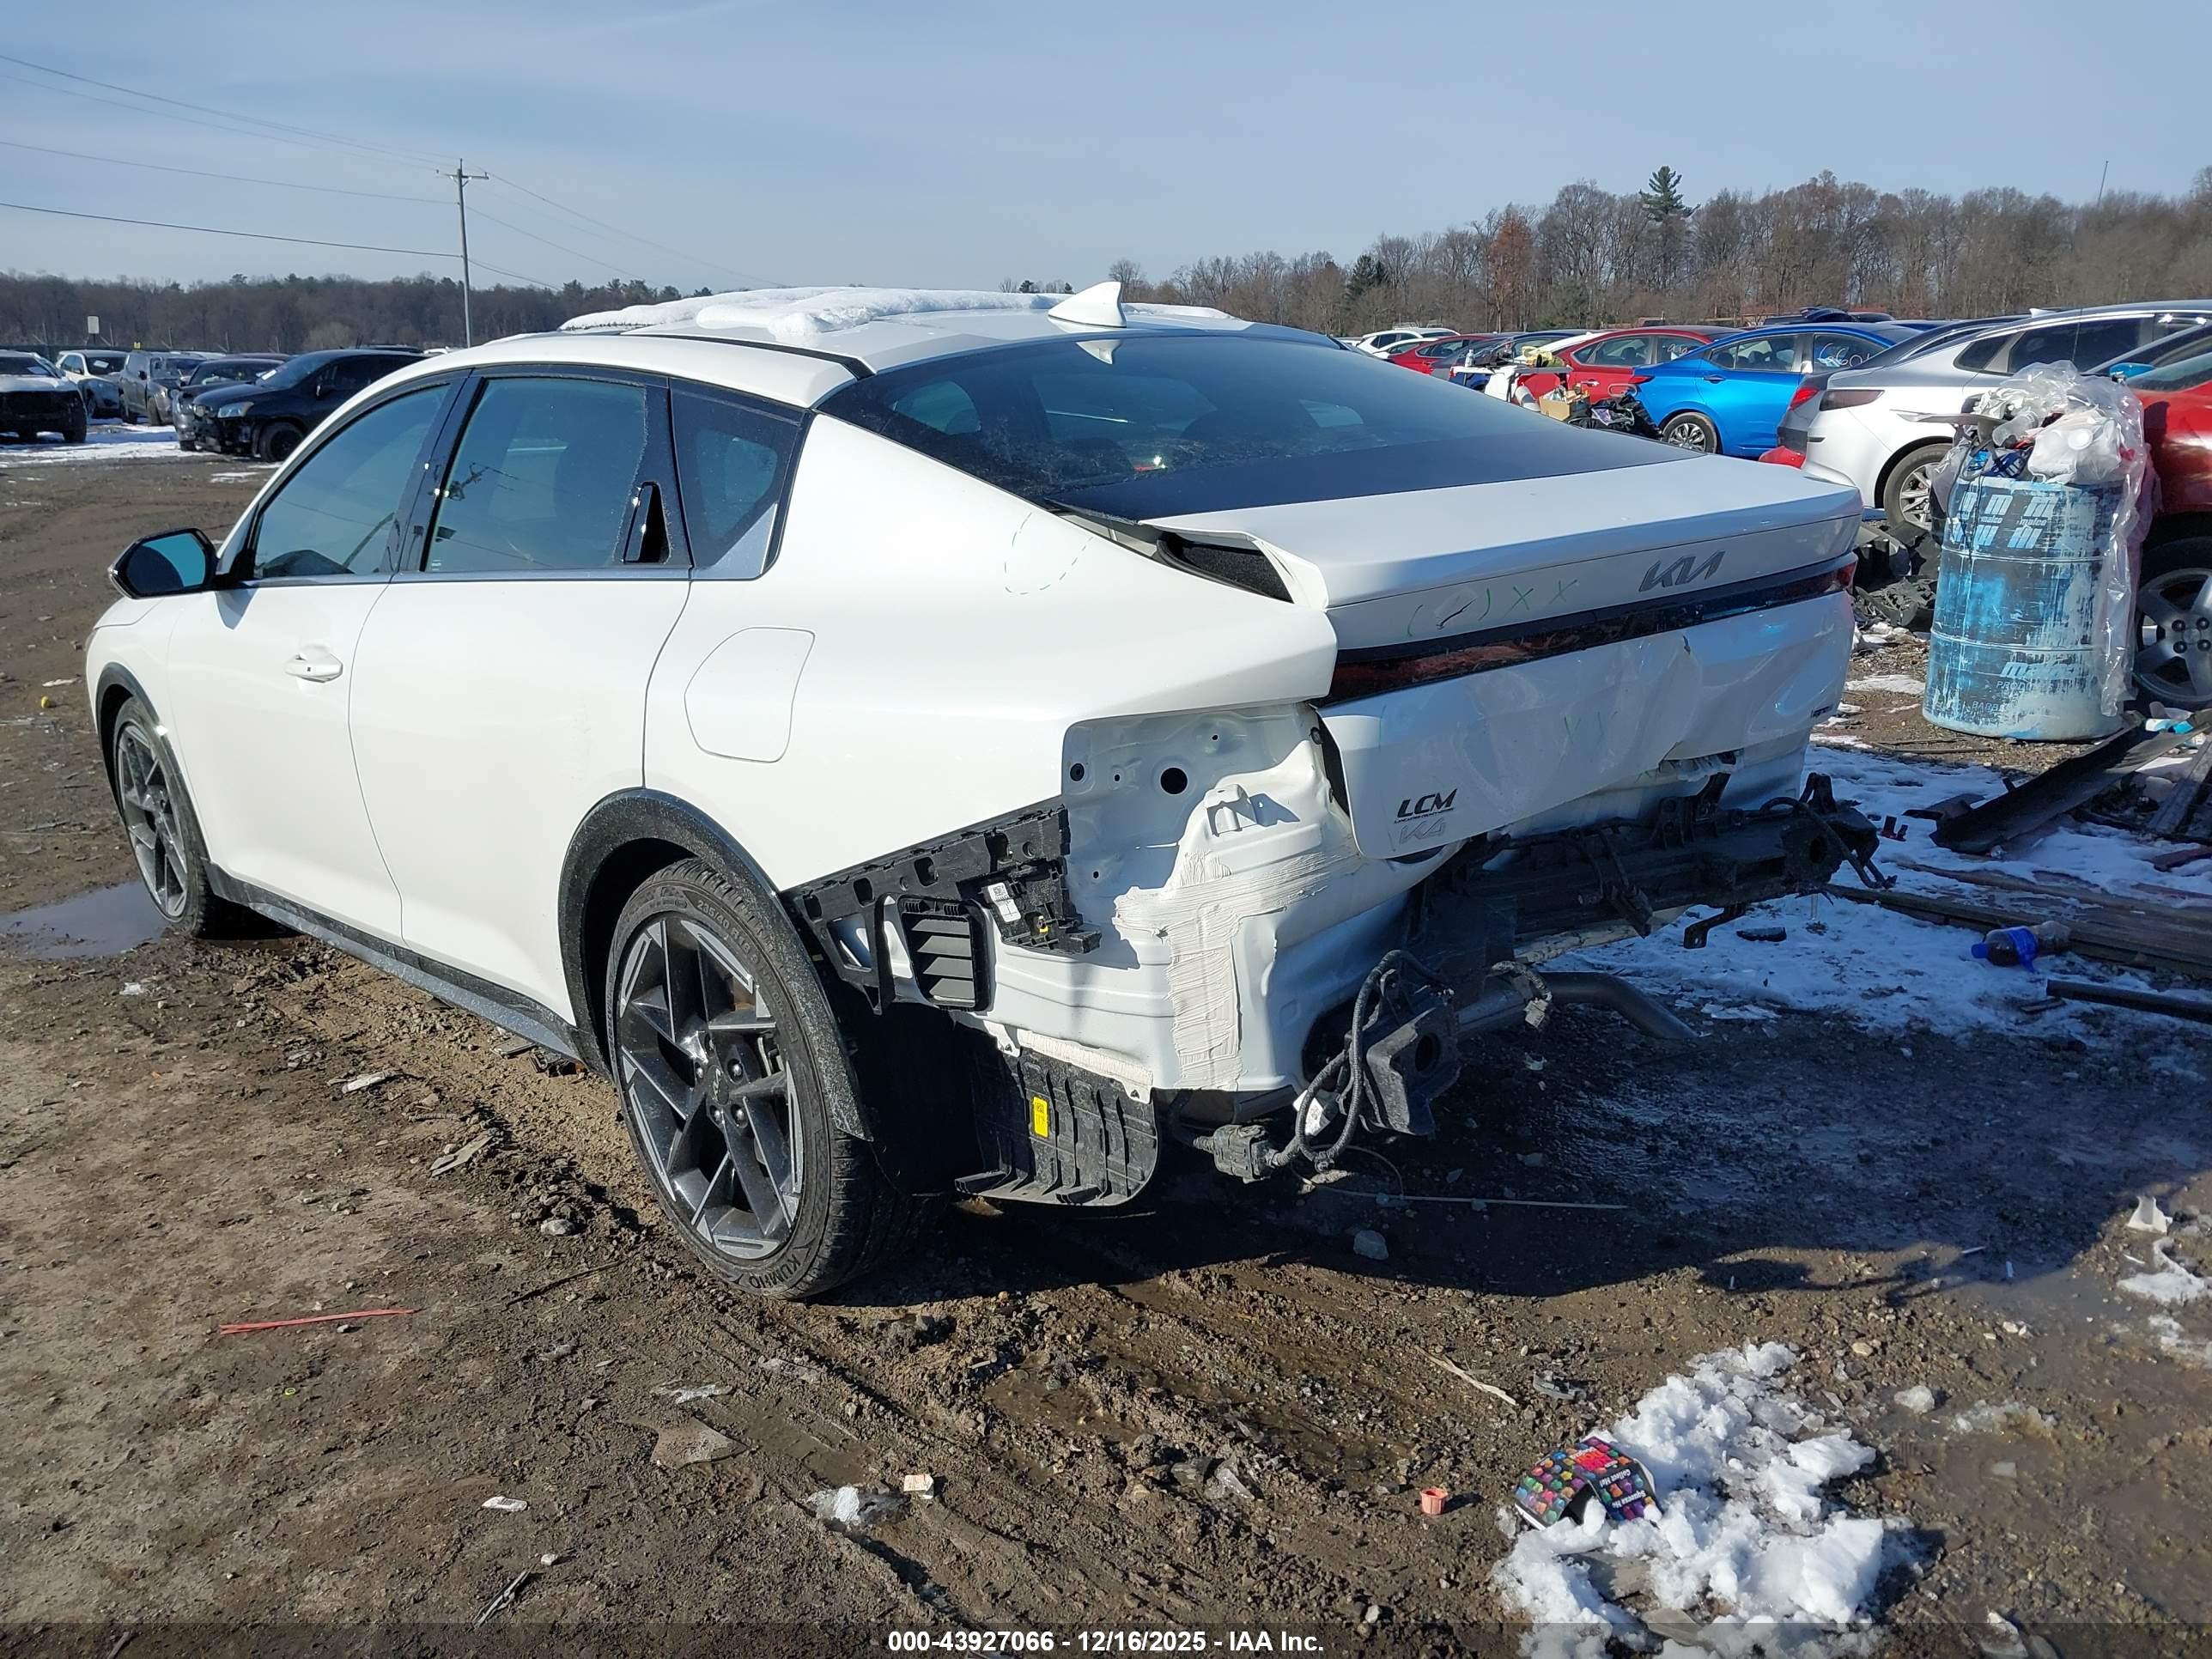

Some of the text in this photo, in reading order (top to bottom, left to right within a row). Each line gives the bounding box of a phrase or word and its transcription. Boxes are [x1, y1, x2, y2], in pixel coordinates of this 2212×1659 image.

[1638, 550, 1726, 592] KIA
[1397, 788, 1457, 818] LCM
[748, 1254, 801, 1289] KUMHO
